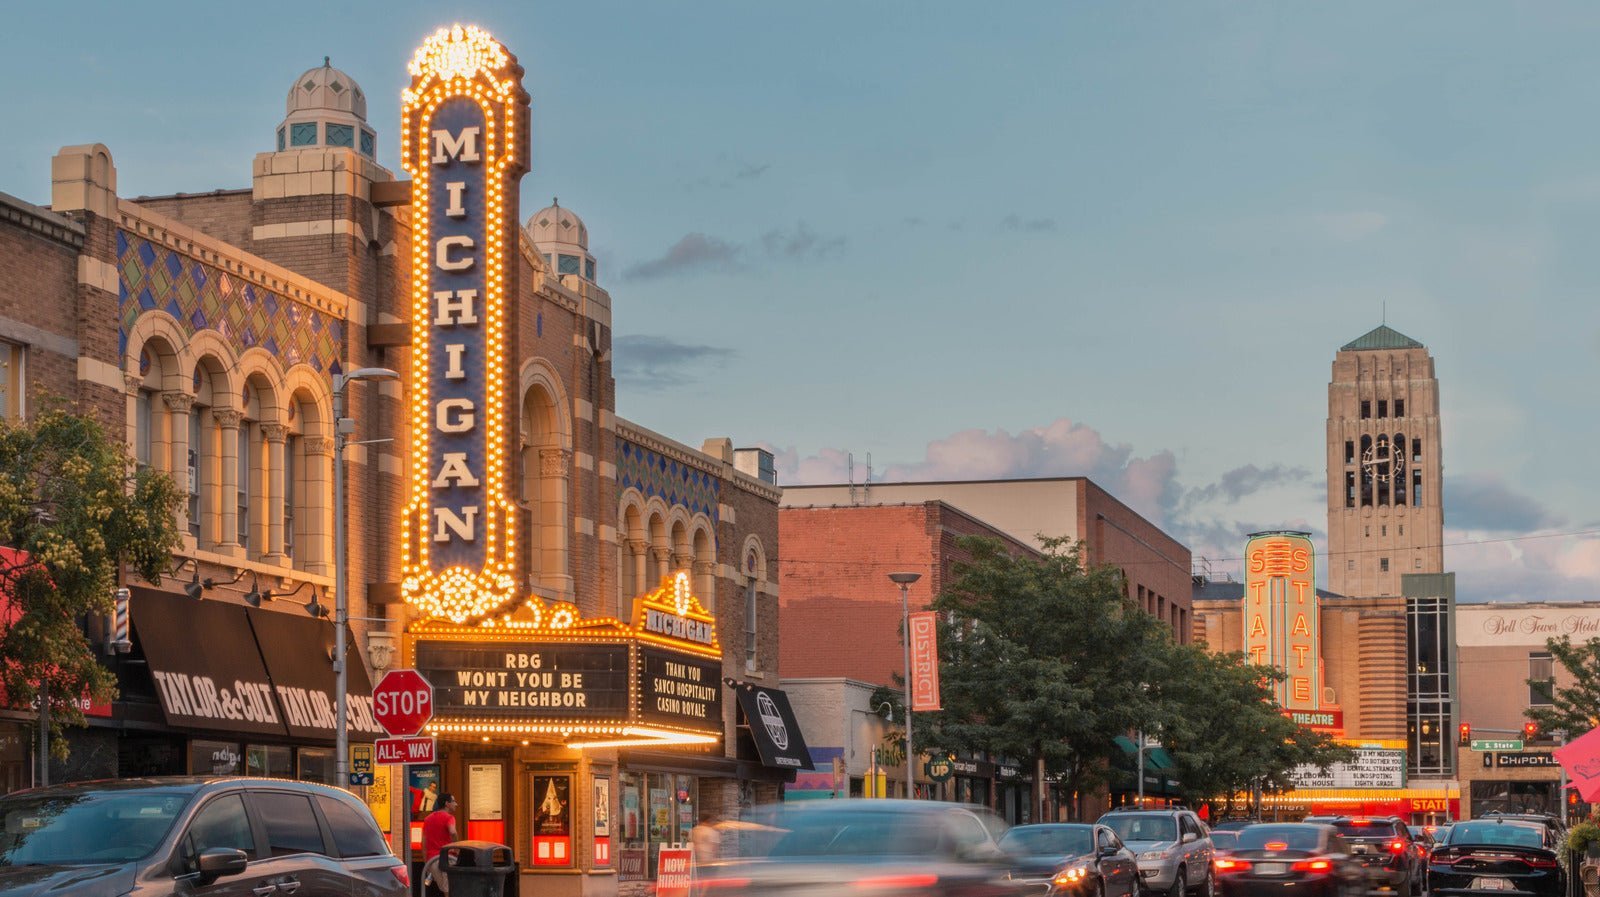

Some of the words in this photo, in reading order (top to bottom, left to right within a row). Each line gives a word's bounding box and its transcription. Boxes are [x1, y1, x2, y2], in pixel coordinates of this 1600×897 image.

[431, 126, 480, 542] MICHIGAN
[1250, 550, 1266, 680] STAT
[1483, 615, 1517, 635] Bell
[1520, 615, 1558, 635] Tower
[1561, 614, 1600, 635] Hotel
[646, 608, 713, 645] MICHIGAN
[1293, 549, 1310, 701] STATE
[505, 653, 541, 669] RBG
[916, 621, 933, 703] DISTRICT
[457, 671, 508, 687] WONT
[516, 672, 553, 689] YOU
[561, 673, 583, 689] BE
[665, 661, 686, 679] THANK
[688, 664, 701, 682] YOU
[464, 690, 490, 706] MY
[498, 691, 587, 708] NEIGHBOR
[654, 677, 675, 696] SAVCO
[676, 681, 717, 702] HOSPITALITY
[376, 690, 429, 716] STOP
[657, 697, 680, 714] CASINO
[682, 700, 706, 718] ROYALE
[1292, 712, 1334, 726] THEATRE
[408, 742, 431, 759] WAY
[1494, 741, 1514, 749] State
[1500, 756, 1560, 764] CHIPOTLE
[931, 765, 949, 777] UP
[664, 858, 687, 873] NOW
[658, 874, 690, 889] HIRING
